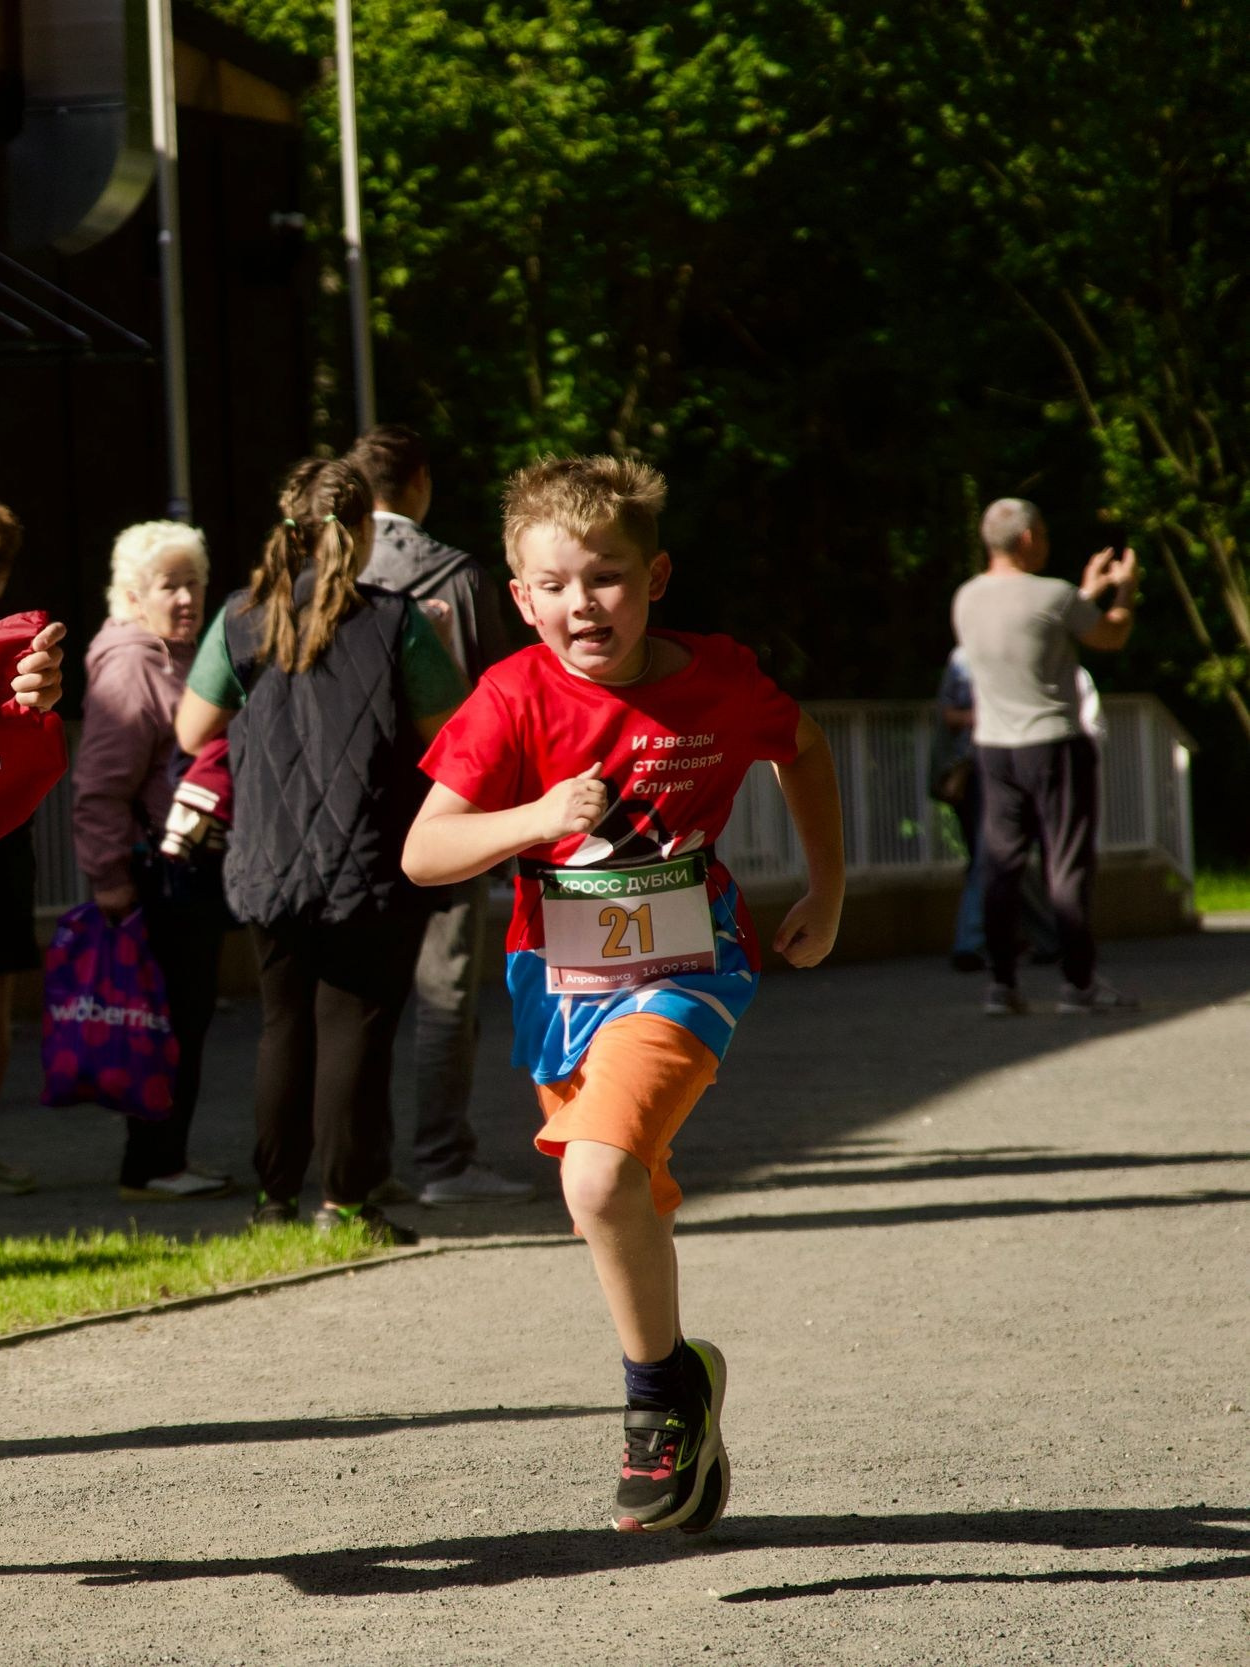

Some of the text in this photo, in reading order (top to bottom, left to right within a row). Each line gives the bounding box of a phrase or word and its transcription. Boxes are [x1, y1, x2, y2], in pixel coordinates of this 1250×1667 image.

[631, 733, 715, 751] И звезды
[633, 779, 694, 795] ближе
[559, 868, 688, 895] КРОСС ДУБКИ
[598, 903, 655, 959] 21
[565, 960, 699, 986] Апрелевка 14.09.25
